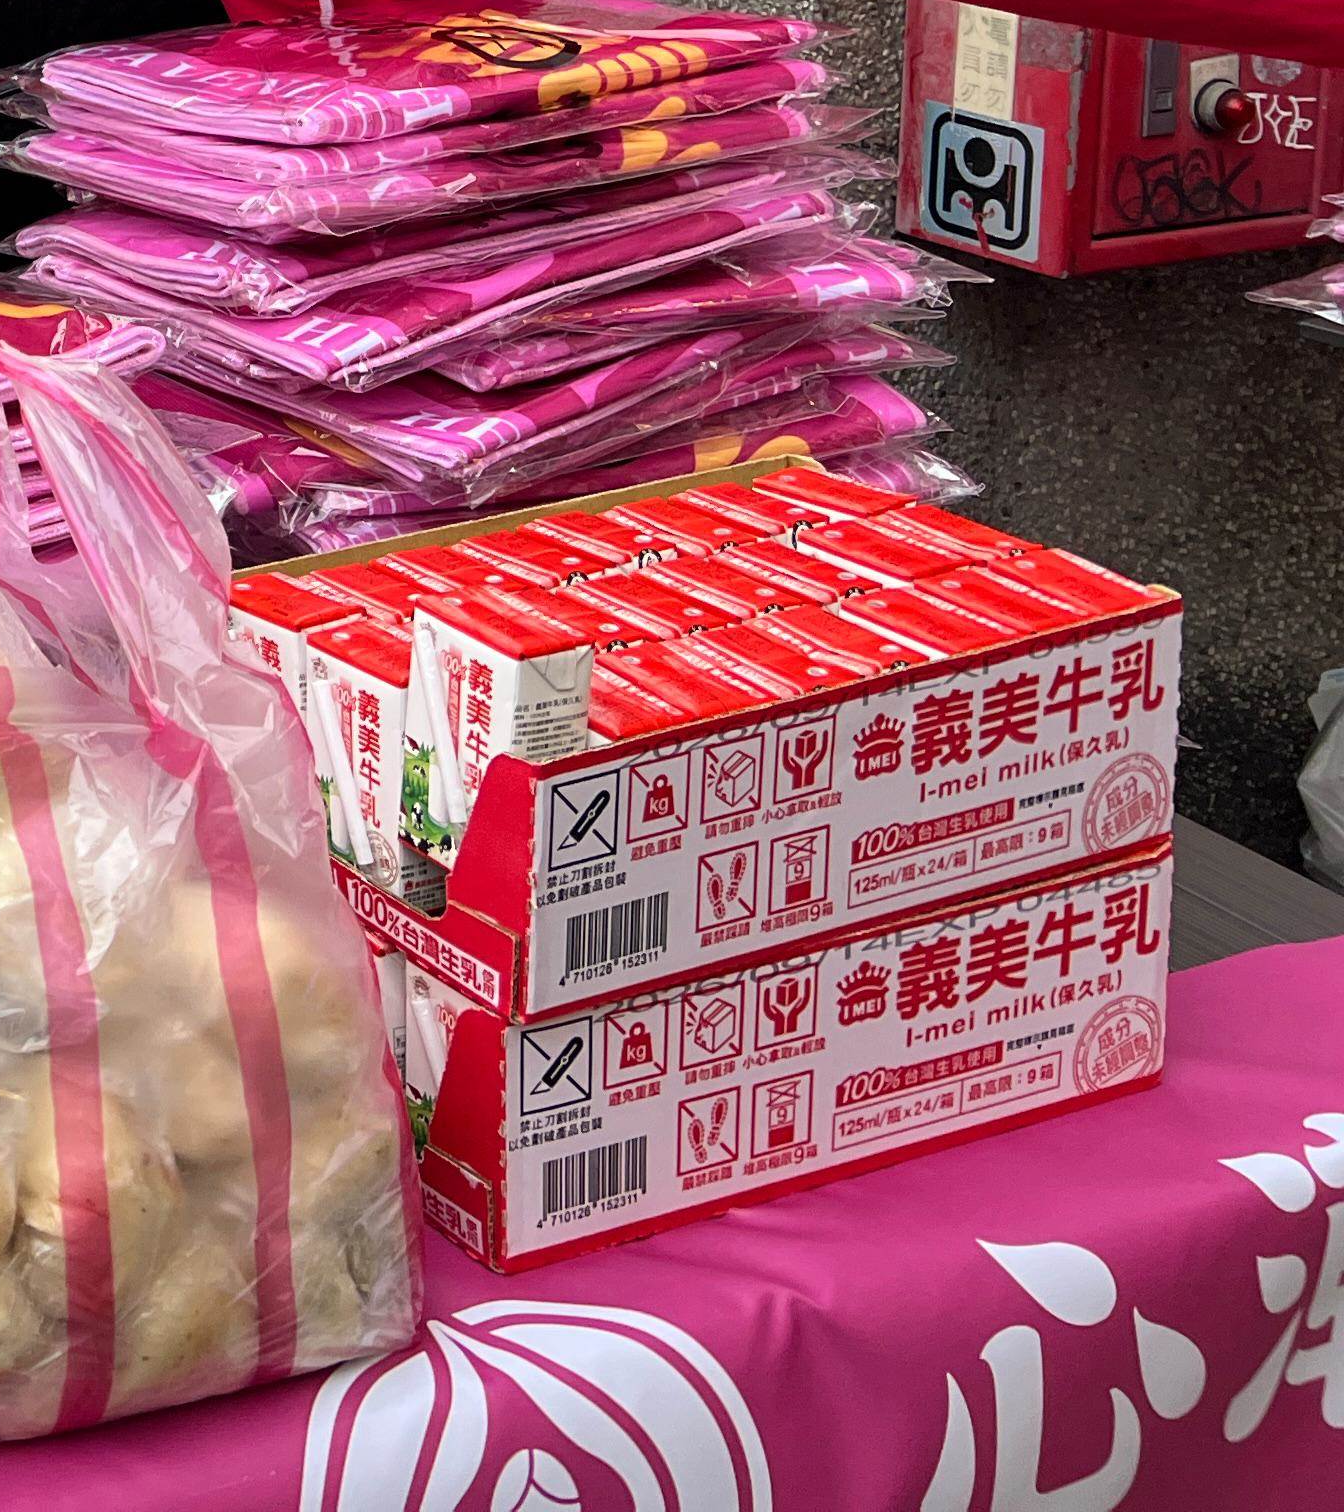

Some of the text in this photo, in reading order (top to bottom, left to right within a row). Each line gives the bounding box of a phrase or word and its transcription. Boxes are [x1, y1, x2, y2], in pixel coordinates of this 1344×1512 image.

[910, 638, 1165, 776] 義美牛乳
[358, 689, 380, 829] 義美牛乳
[649, 794, 668, 815] kg
[920, 774, 987, 804] I-mei
[794, 861, 804, 880] 9
[559, 976, 566, 986] 4
[622, 950, 659, 971] 152311
[896, 883, 1160, 1021] 義美牛乳
[906, 1015, 975, 1048] I-mei
[627, 1043, 647, 1062] kg
[777, 1108, 788, 1121] 9
[537, 1219, 543, 1229] 4
[601, 1193, 638, 1212] 152311
